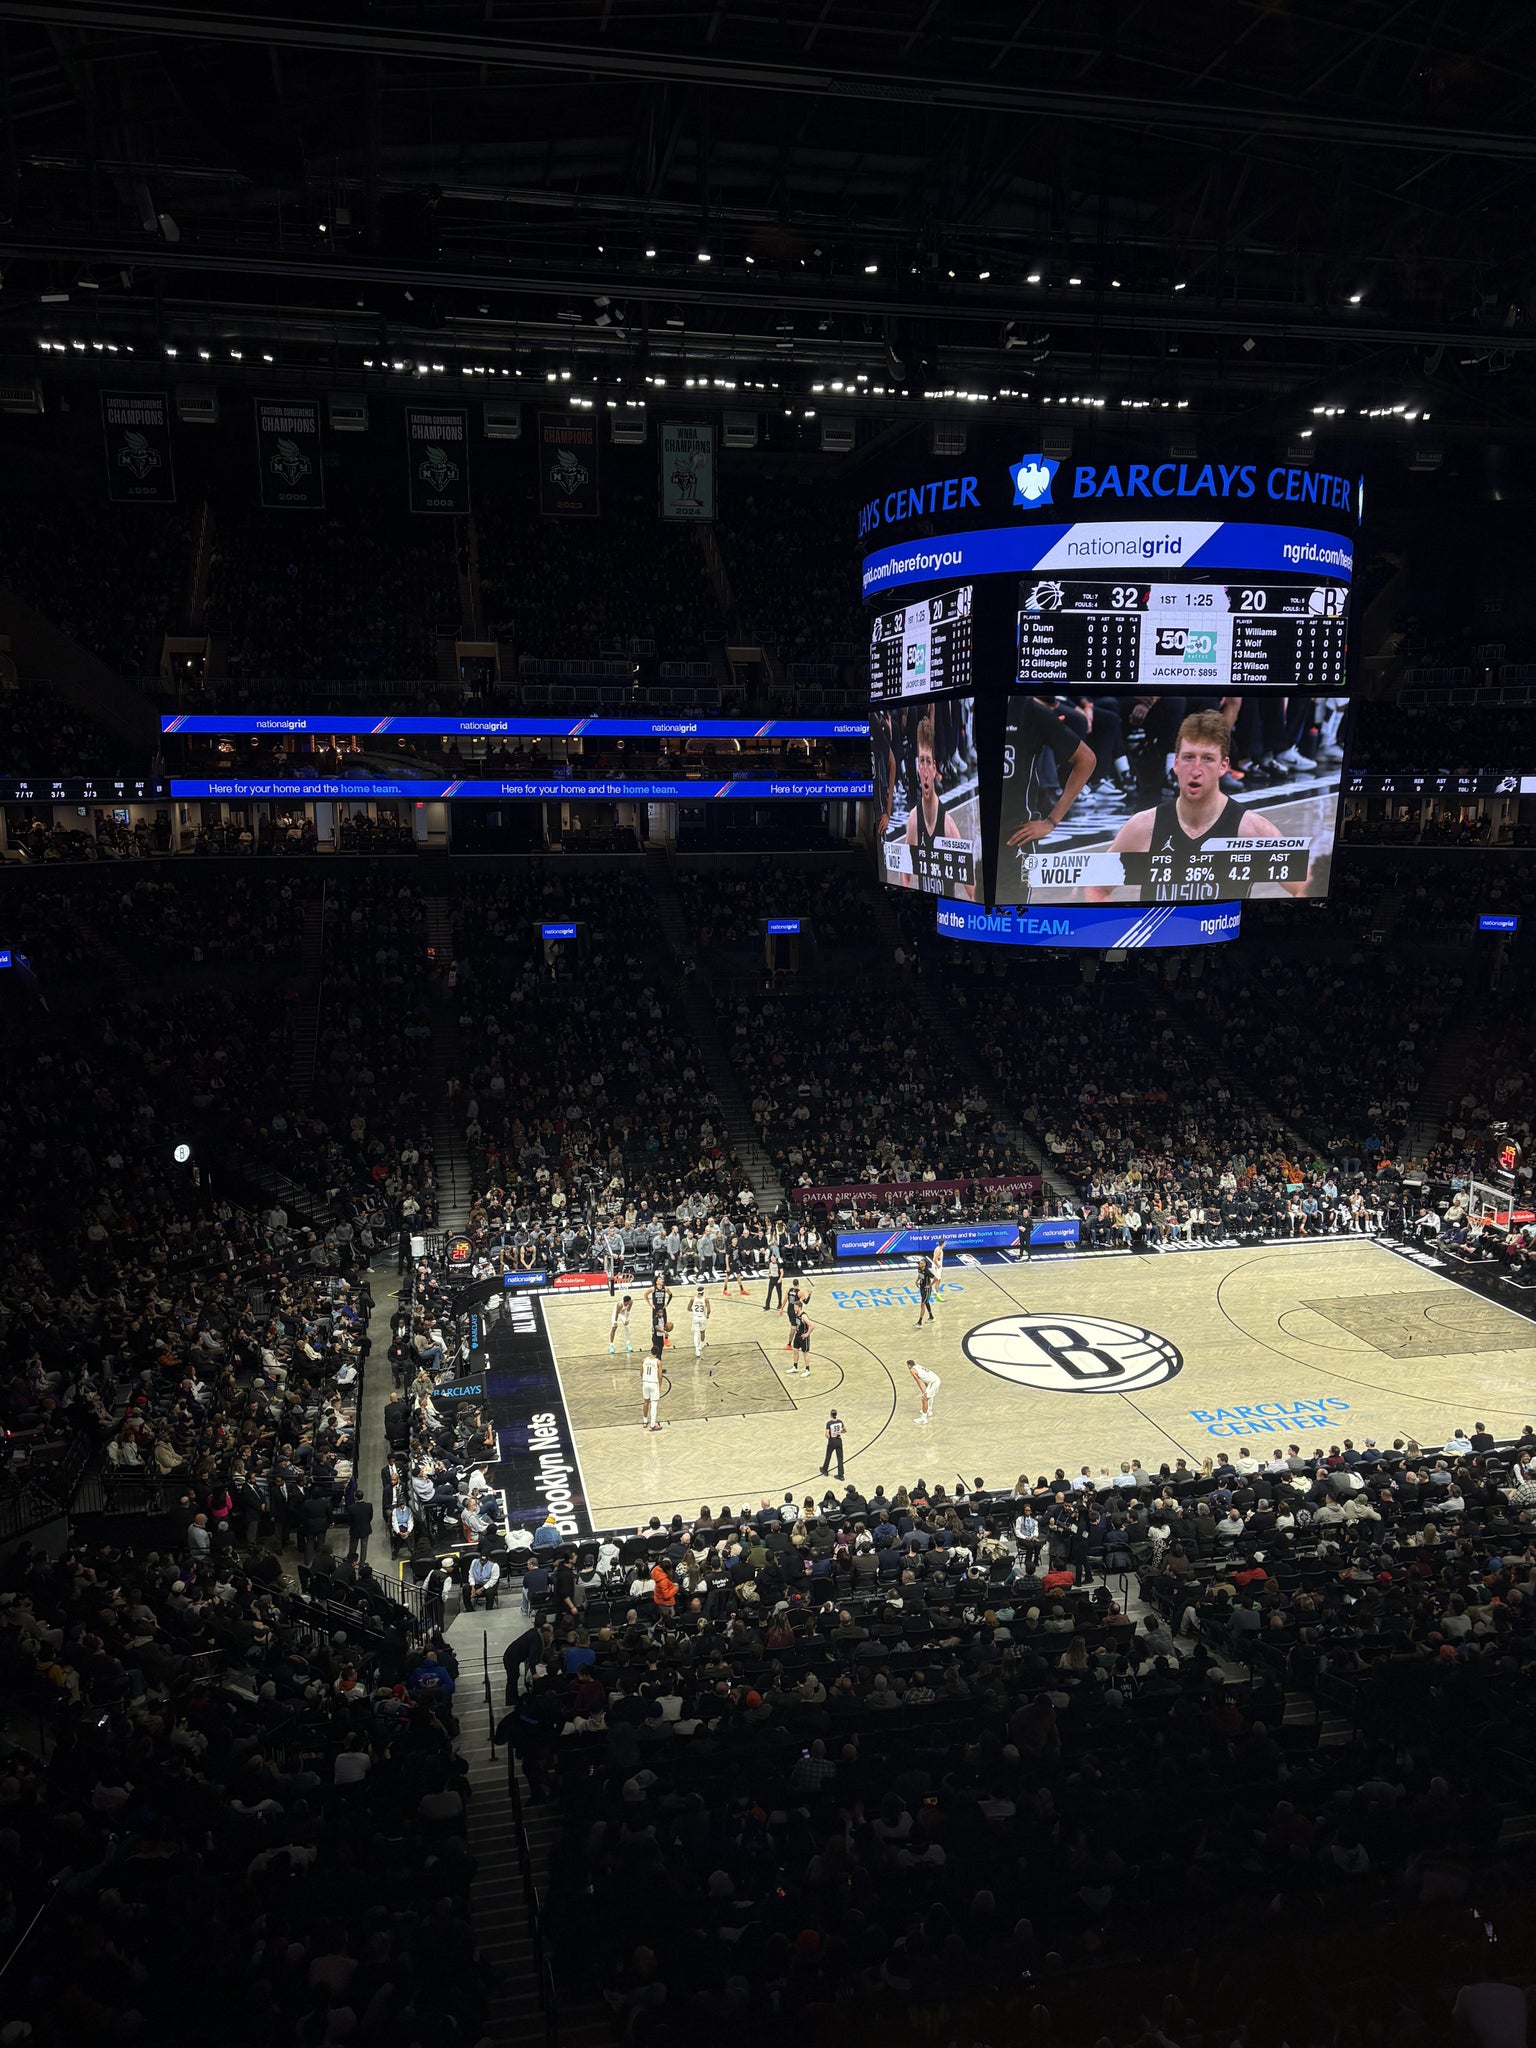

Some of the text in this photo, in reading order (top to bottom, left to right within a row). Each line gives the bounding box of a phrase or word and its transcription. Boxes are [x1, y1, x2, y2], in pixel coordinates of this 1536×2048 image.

[108, 409, 163, 425] CHAMPIONS
[261, 417, 315, 433] CHAMPIONS
[412, 425, 463, 441] CHAMPIONS
[544, 430, 592, 445] CHAMPIONS
[677, 428, 697, 439] WNBA
[665, 440, 710, 453] CHAMPIONS
[1073, 464, 1350, 512] BARCLAYS CENTER
[426, 499, 454, 507] 2002
[884, 477, 980, 523] CENTER
[1068, 534, 1182, 559] nationalgrid
[1111, 587, 1138, 608] 32
[1160, 594, 1213, 606] 1ST 1:25
[1240, 590, 1266, 611] 20
[933, 600, 943, 620] 20
[894, 613, 902, 632] 32
[1245, 628, 1277, 636] Williams
[1032, 636, 1053, 644] Allen
[1245, 639, 1262, 647] Wolf
[1032, 648, 1068, 656] Ighodaro
[1243, 651, 1267, 659] Martin
[1031, 659, 1067, 668] Gillespie
[1243, 662, 1269, 670] Wilson
[1031, 671, 1067, 679] Goodwin
[1153, 668, 1218, 677] JACKPOT: $895
[256, 719, 307, 730] nationalgrid
[460, 721, 508, 733] nationalgrid
[651, 722, 697, 734] nationalgrid
[209, 784, 401, 796] Here for your home and the home team.
[502, 784, 678, 796] Here for your home and the home team.
[770, 784, 866, 795] Here for your home and
[941, 840, 970, 850] THIS SEASON
[1225, 839, 1304, 848] THIS SEASON
[958, 855, 966, 864] AST
[1042, 855, 1091, 868] 2 DANNY
[1152, 855, 1173, 865] PTS
[1189, 855, 1214, 864] 3-PT
[1229, 854, 1252, 863] REB
[1269, 853, 1290, 862] AST
[1041, 868, 1082, 884] WOLF
[1150, 868, 1172, 883] 7.8
[1185, 867, 1215, 882] 36%
[1228, 867, 1250, 881] 4.2
[1267, 866, 1289, 880] 1.8
[939, 912, 1075, 935] and the HOME TEAM.
[1500, 1151, 1514, 1169] 24
[1042, 1229, 1074, 1237] nationalgrid
[841, 1241, 875, 1249] nationalgrid
[453, 1250, 466, 1260] 24
[507, 1275, 543, 1283] nationalgrid
[694, 1304, 704, 1313] 23
[1019, 1325, 1125, 1380] B
[433, 1385, 482, 1397] BARCLAYS
[1190, 1397, 1350, 1423] BARCLAYS
[1207, 1414, 1342, 1437] CENTER
[528, 1413, 578, 1536] Brooklyn Nets
